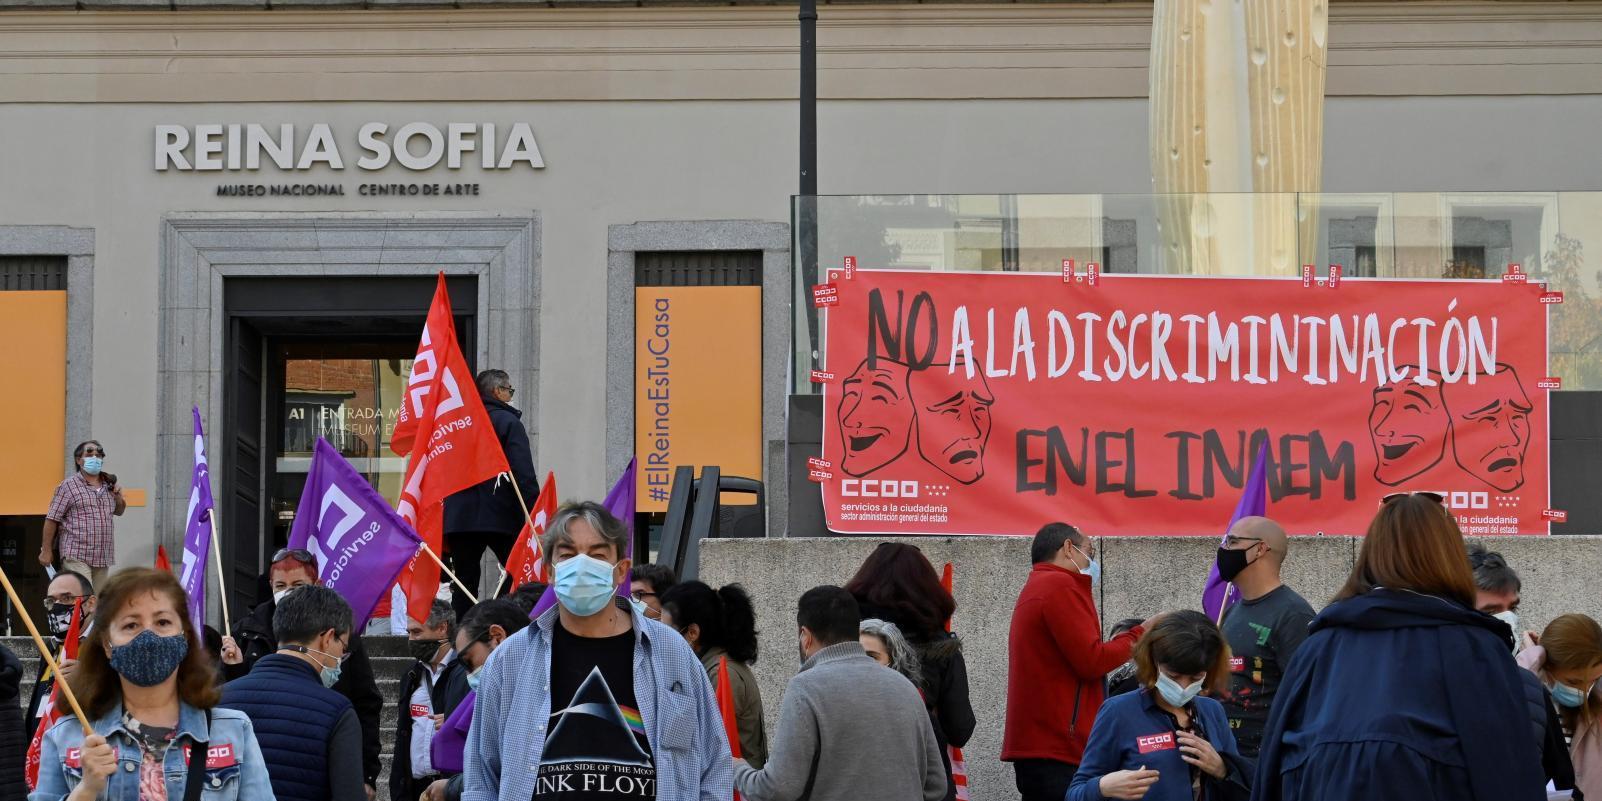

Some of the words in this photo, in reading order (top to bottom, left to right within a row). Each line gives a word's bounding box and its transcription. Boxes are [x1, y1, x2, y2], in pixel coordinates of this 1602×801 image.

[155, 123, 344, 171] REINA
[357, 122, 546, 170] SOFIA
[217, 184, 266, 196] MUSEO
[270, 183, 345, 196] NACIONAL
[358, 183, 419, 196] CENTRO
[422, 184, 440, 195] DE
[443, 183, 480, 195] ARTE
[867, 288, 938, 371] NO
[949, 305, 975, 380] A
[986, 306, 1036, 382] LA
[1047, 297, 1497, 387] DISCRIMININACIÓN
[812, 371, 834, 379] CCOO
[645, 298, 669, 502] #ElReinaEsTuCasa
[288, 407, 305, 420] A1
[322, 407, 384, 420] ENTRADA
[388, 408, 400, 419] M
[321, 423, 381, 436] MUSEUM
[809, 458, 831, 468] CCOO
[1016, 425, 1089, 496] EN
[1095, 427, 1158, 499] EL
[1164, 427, 1356, 503] INAEM
[810, 470, 833, 479] CCOO
[842, 479, 918, 498] CCOO
[841, 503, 880, 512] servicios
[891, 503, 898, 512] la
[900, 503, 948, 513] ciudadanía
[1542, 509, 1566, 518] CCOO
[840, 512, 858, 520] sector
[859, 511, 898, 521] administración
[899, 513, 919, 524] general
[920, 513, 928, 522] del
[929, 513, 948, 523] estado
[1460, 515, 1468, 524] la
[1470, 515, 1518, 524] ciudadanía
[1470, 525, 1489, 535] general
[1491, 525, 1499, 533] del
[1500, 525, 1518, 534] estado
[1140, 734, 1172, 747] CCOO
[185, 746, 230, 758] COO
[547, 763, 572, 773] DARK
[574, 763, 596, 772] SIDE
[597, 763, 610, 771] OF
[614, 765, 632, 774] THE
[536, 773, 576, 795] INK
